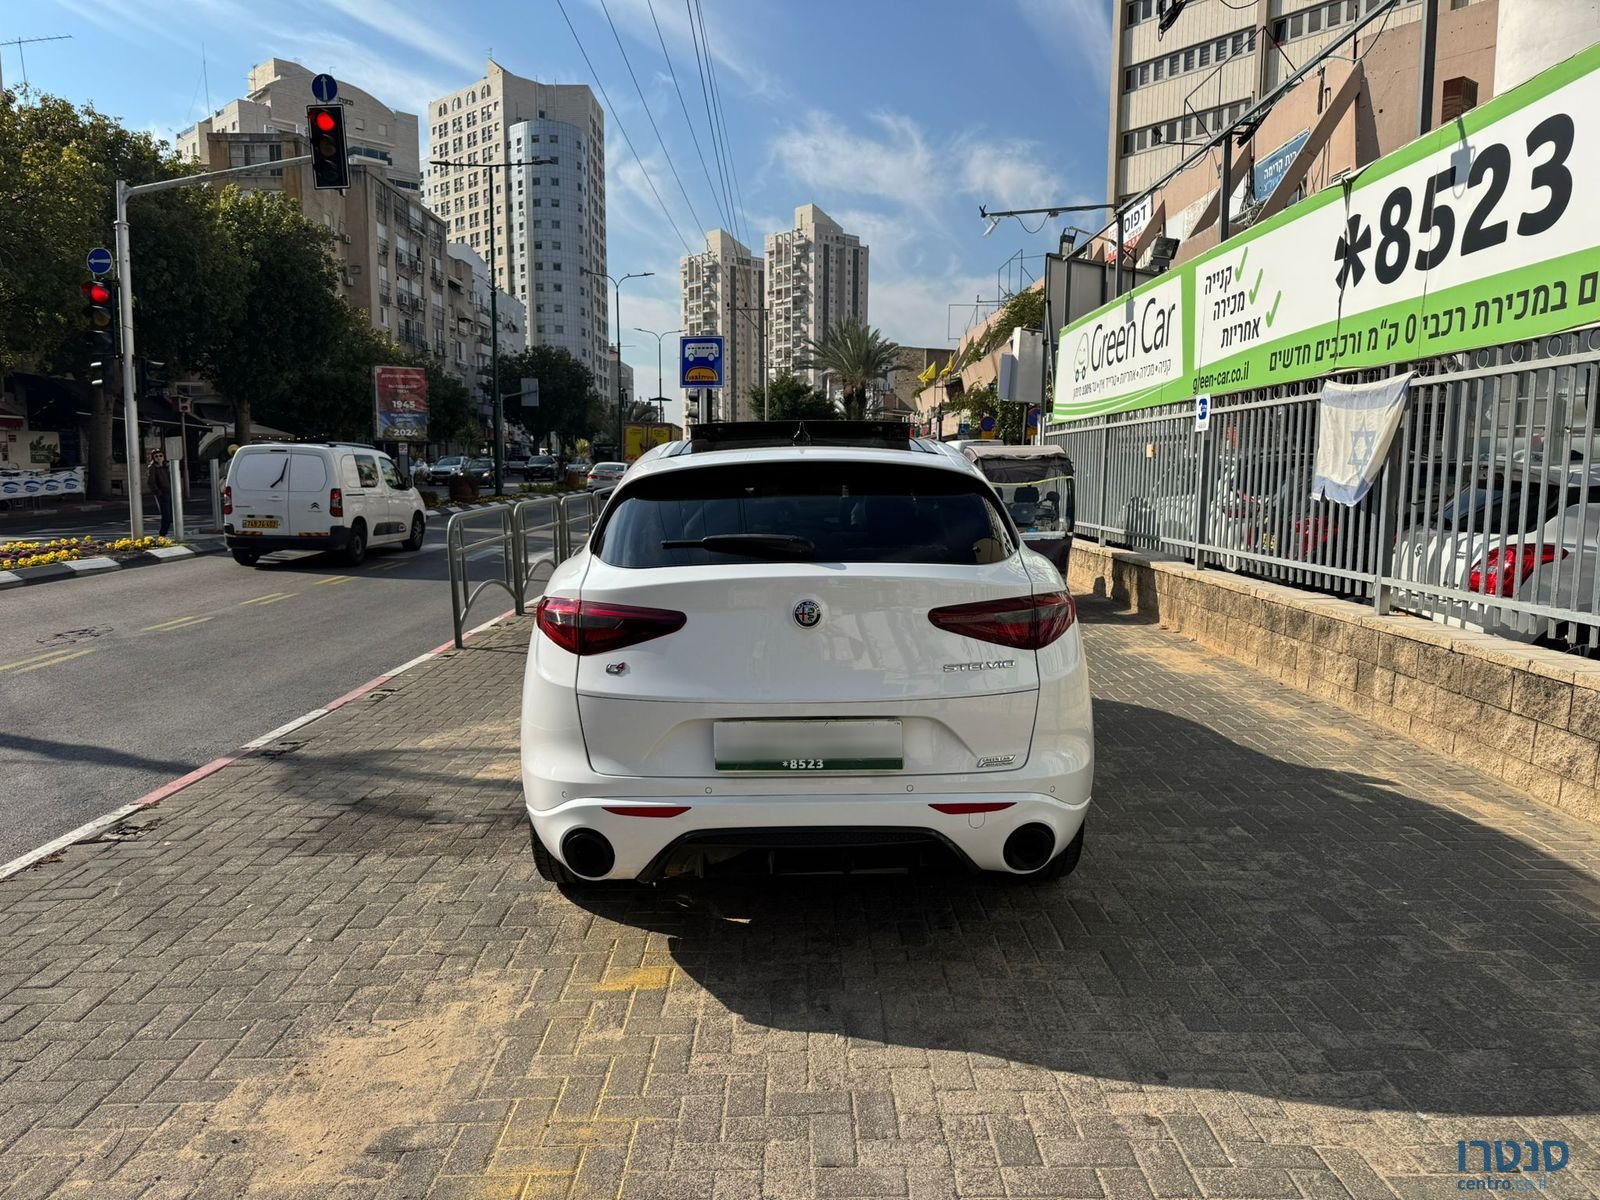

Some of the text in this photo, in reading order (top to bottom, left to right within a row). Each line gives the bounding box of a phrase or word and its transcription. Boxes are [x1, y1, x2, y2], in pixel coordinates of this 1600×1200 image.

[1124, 204, 1147, 233] דפוס
[1205, 265, 1232, 295] קנייה
[1213, 291, 1246, 321] מכירה
[1472, 280, 1568, 330] במכירת
[1091, 297, 1176, 372] Green Car
[1220, 317, 1261, 348] אחריות
[1405, 313, 1417, 344] 0
[1422, 306, 1466, 340] רכבי
[1269, 344, 1312, 372] חדשים
[1315, 331, 1362, 362] ורכבים
[1193, 361, 1250, 394] green-car.co.il
[392, 401, 416, 409] 1945
